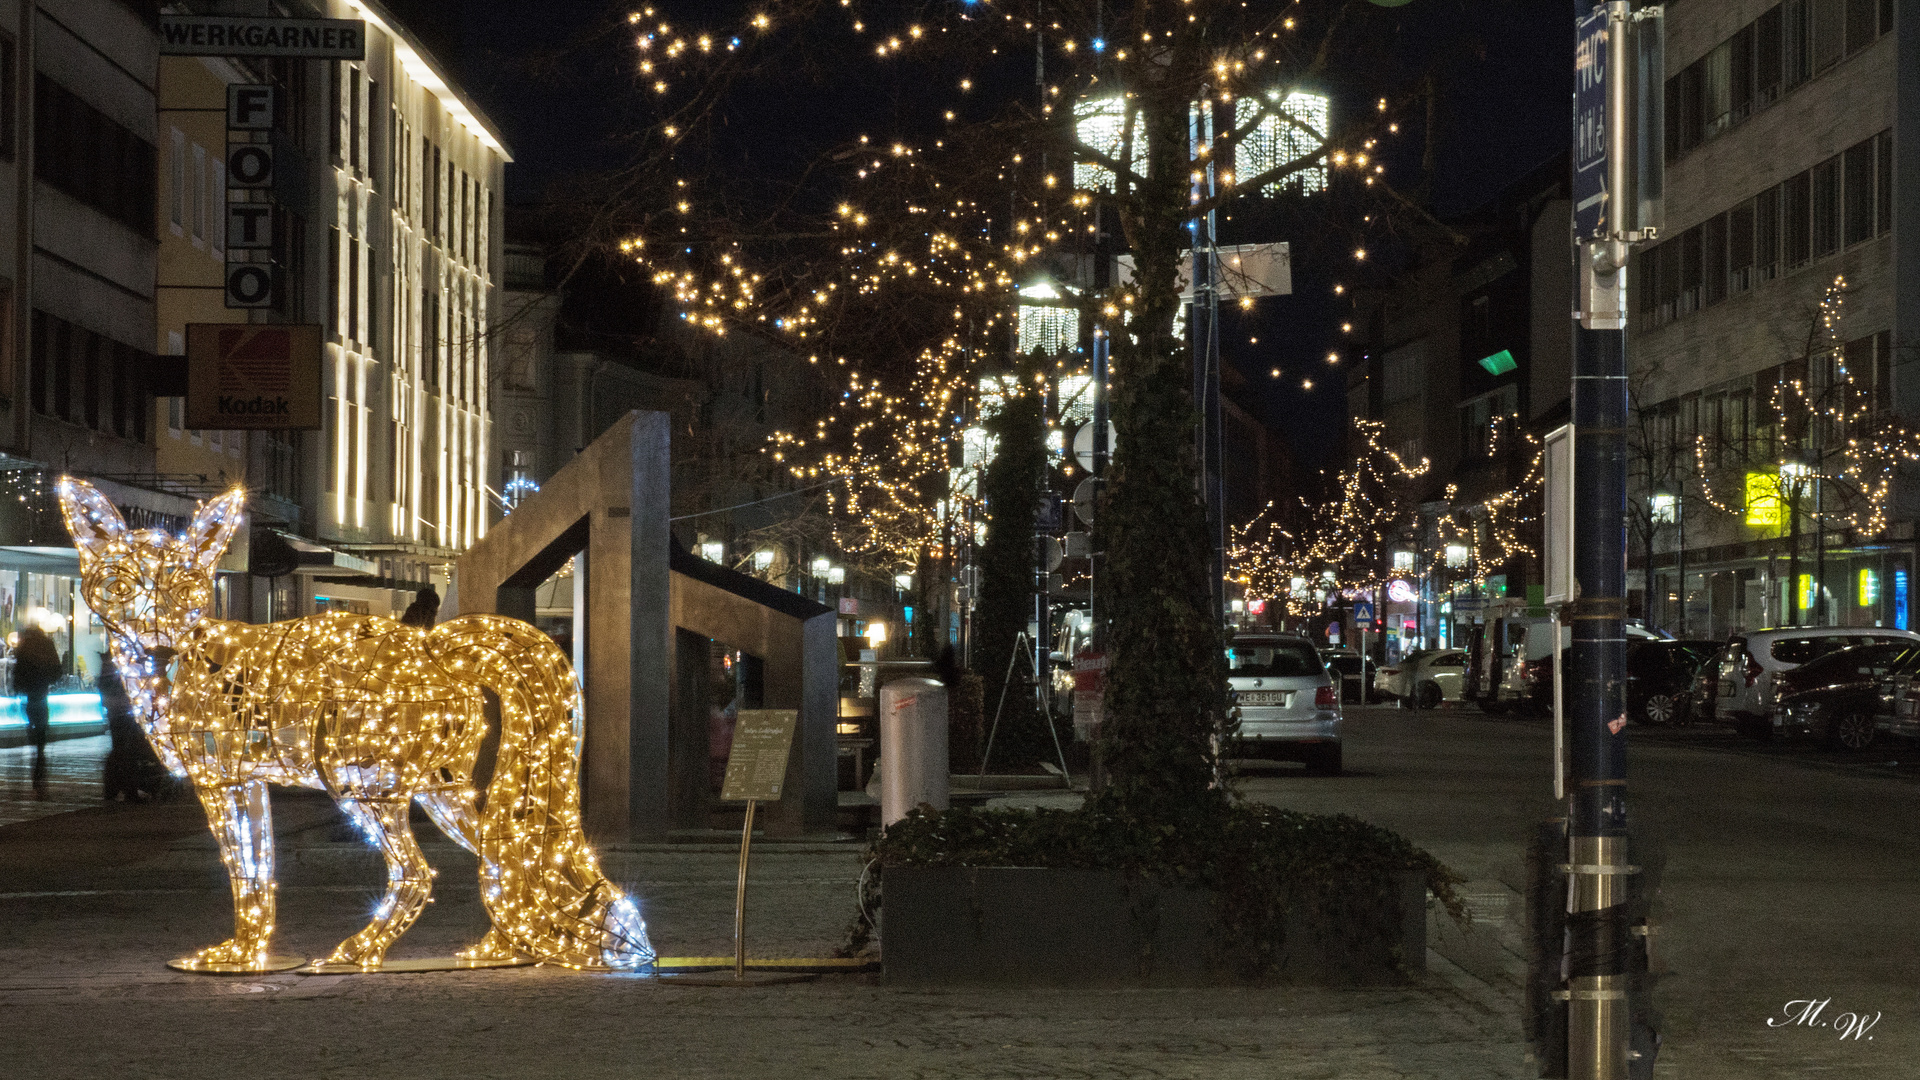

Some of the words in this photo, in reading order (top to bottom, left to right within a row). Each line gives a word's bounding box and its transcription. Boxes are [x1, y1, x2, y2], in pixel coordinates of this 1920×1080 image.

[163, 23, 357, 49] WERKGARNER
[1579, 29, 1604, 92] WC
[229, 89, 271, 303] FOTO
[218, 395, 289, 415] Kodak
